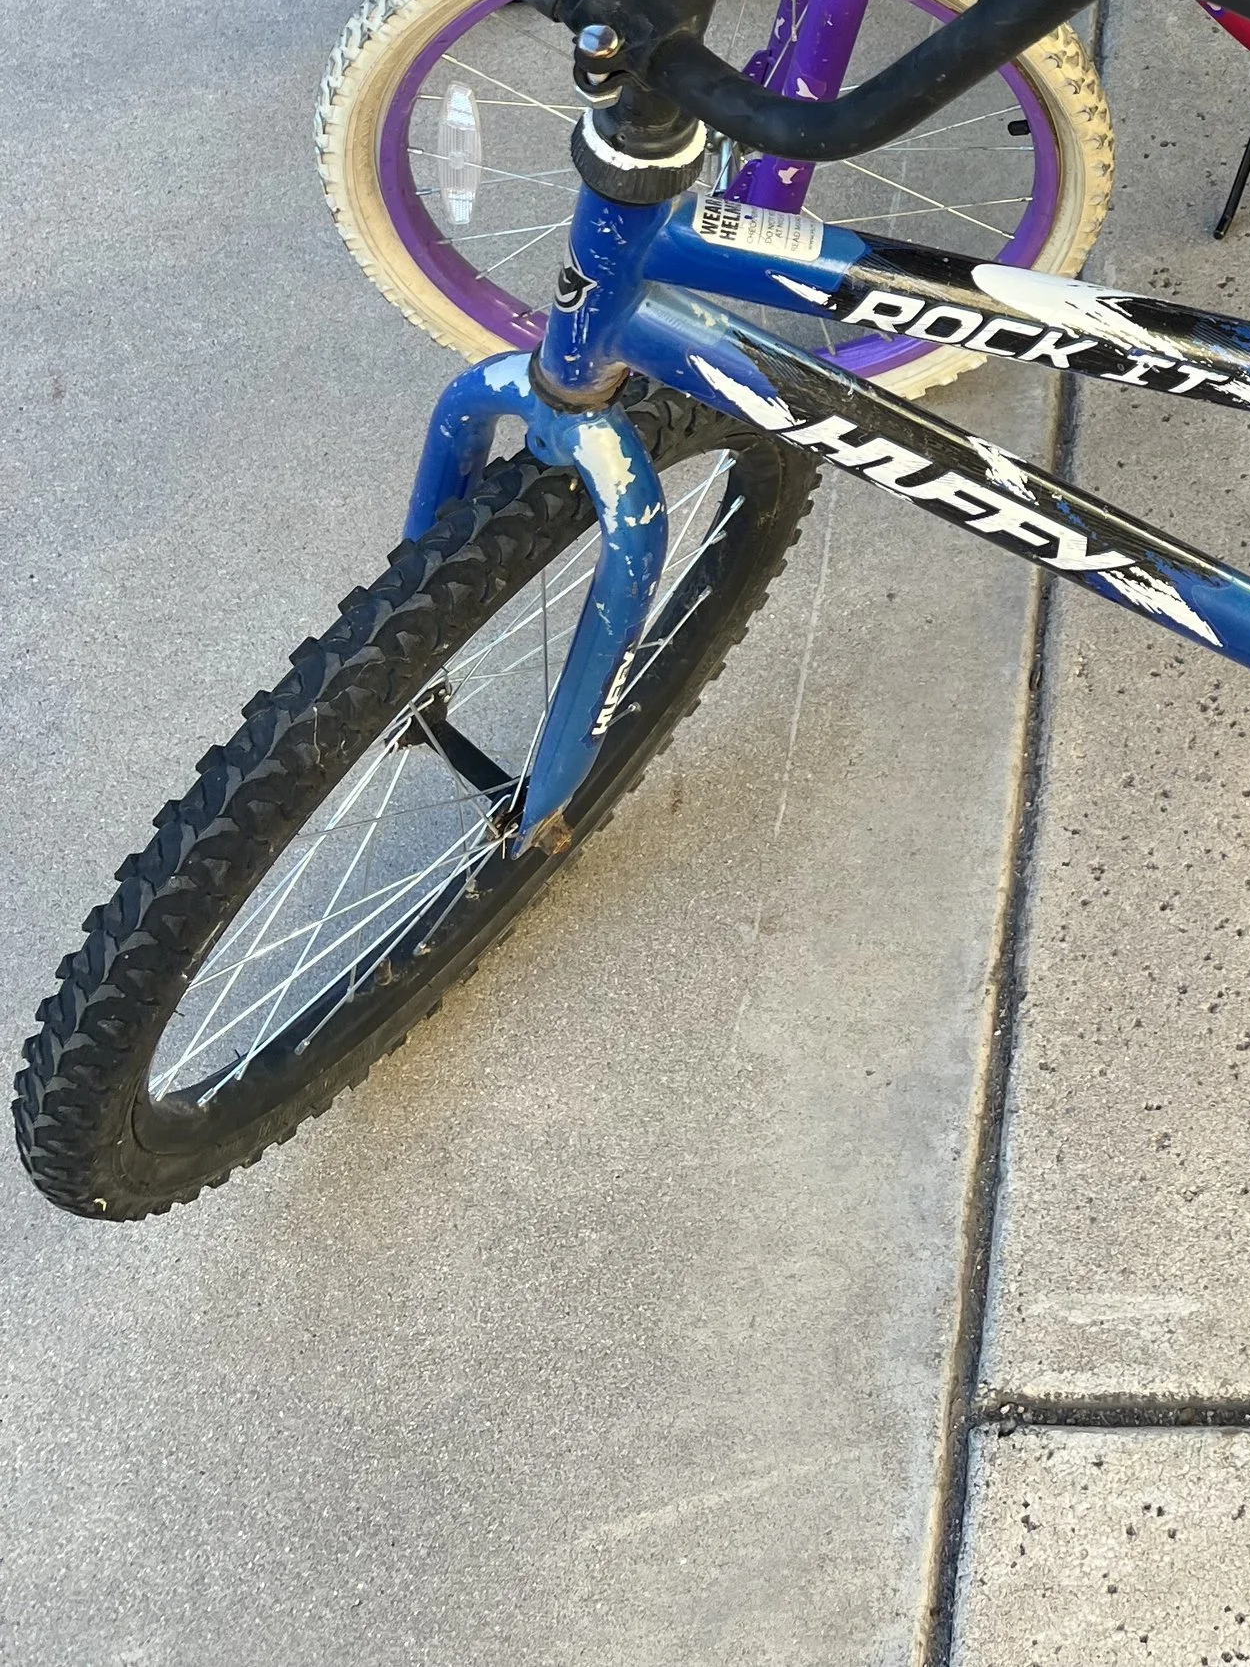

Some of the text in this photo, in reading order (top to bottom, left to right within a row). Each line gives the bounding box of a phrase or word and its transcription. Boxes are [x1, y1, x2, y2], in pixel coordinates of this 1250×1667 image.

[841, 290, 1230, 394] ROCK IT
[780, 415, 1136, 571] HUFFY
